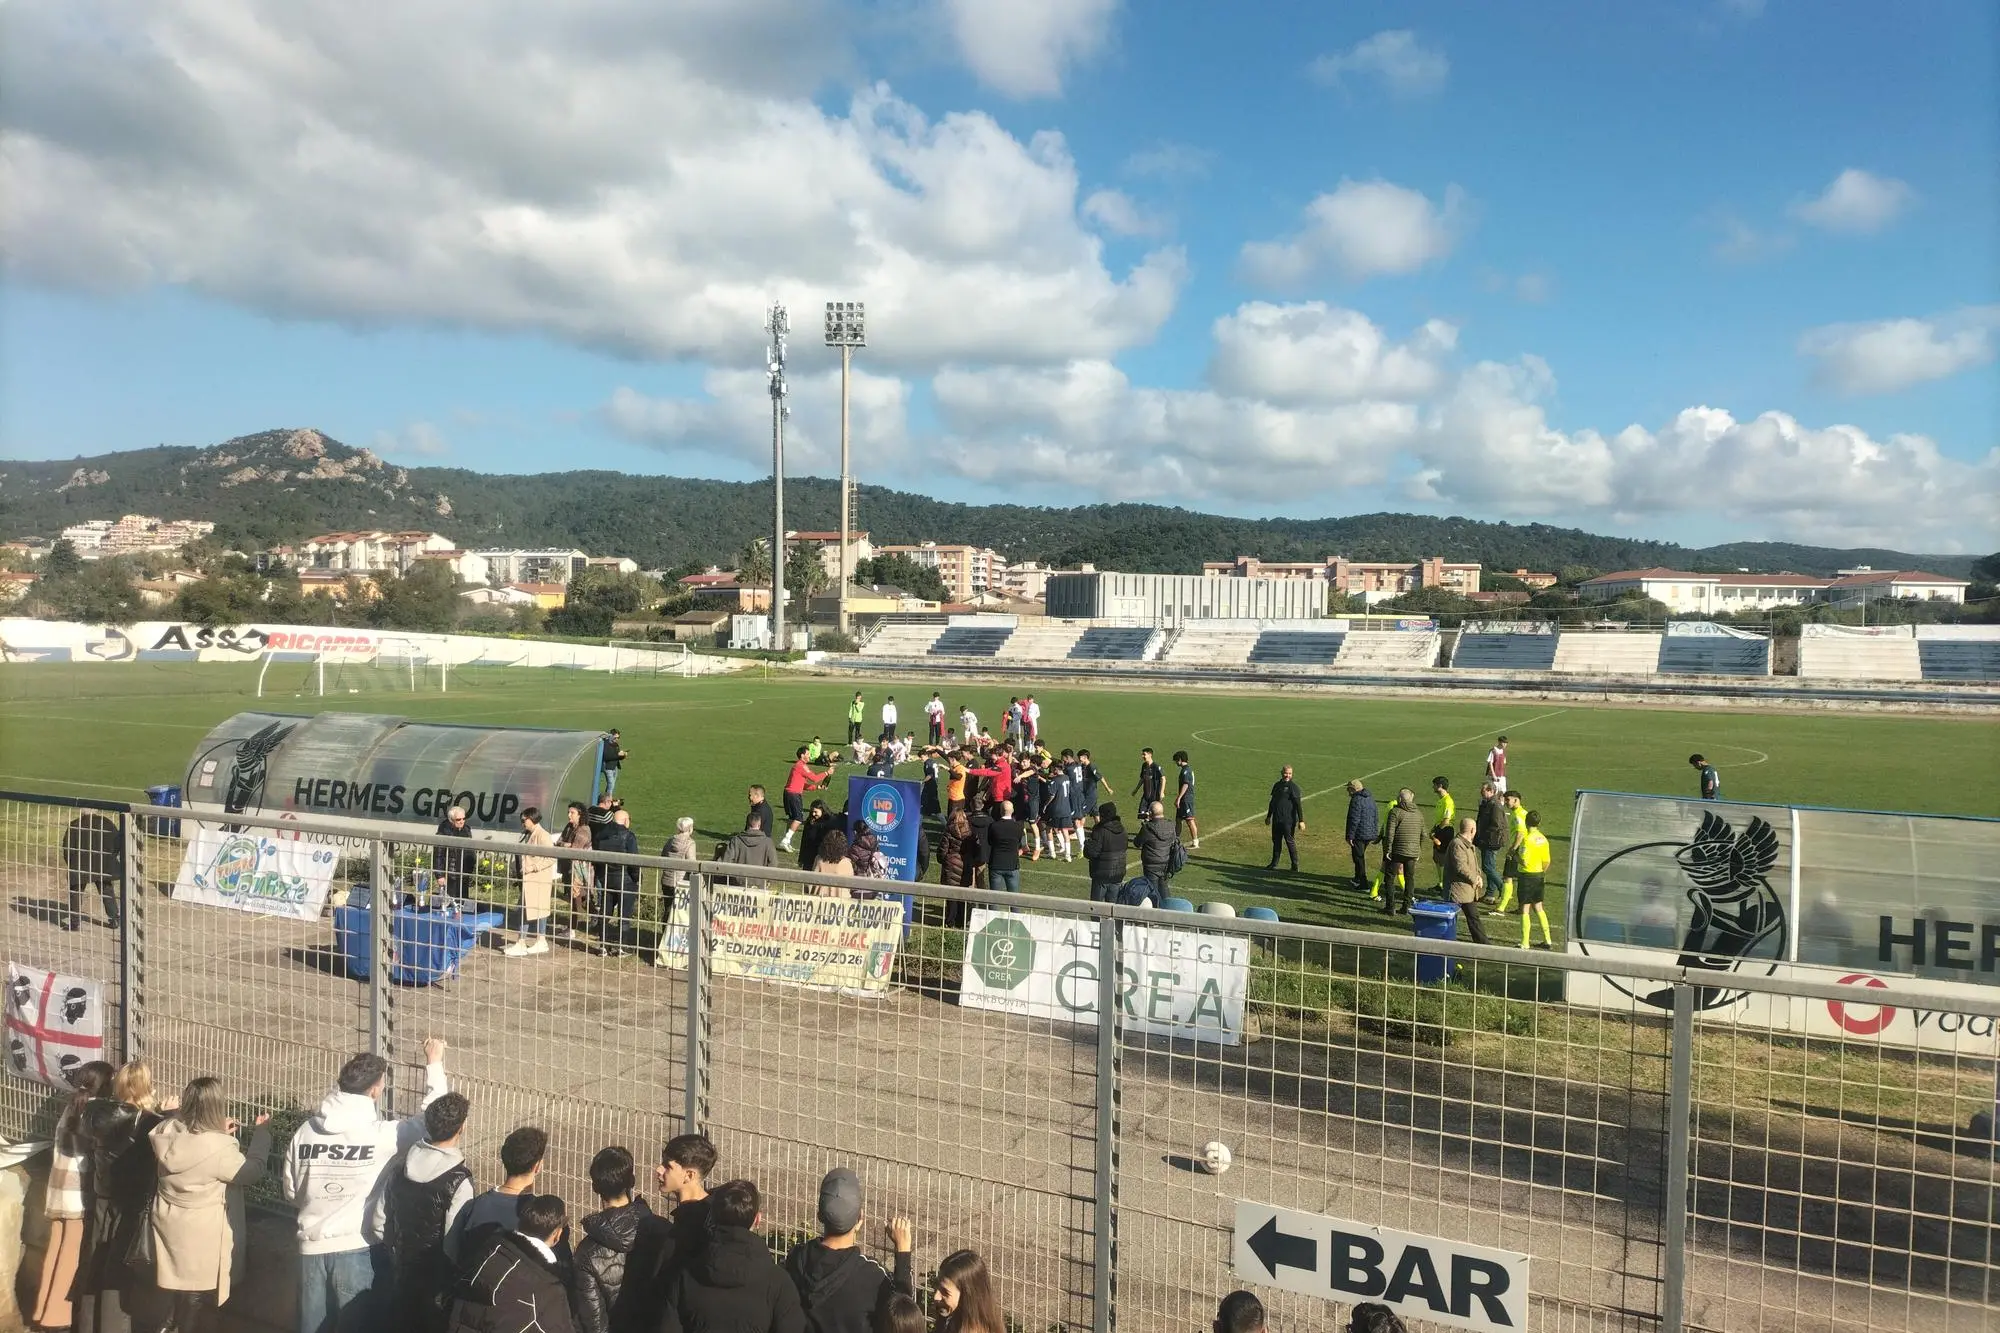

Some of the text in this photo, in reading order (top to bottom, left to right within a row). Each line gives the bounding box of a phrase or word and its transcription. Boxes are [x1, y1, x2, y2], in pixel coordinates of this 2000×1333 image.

[294, 777, 519, 824] HERMES GROUP
[726, 942, 782, 959] EDIZIONE
[794, 948, 864, 966] 2025/2026
[988, 971, 1012, 982] CREA
[1055, 960, 1232, 1034] CREA
[1330, 1229, 1514, 1328] BAR
